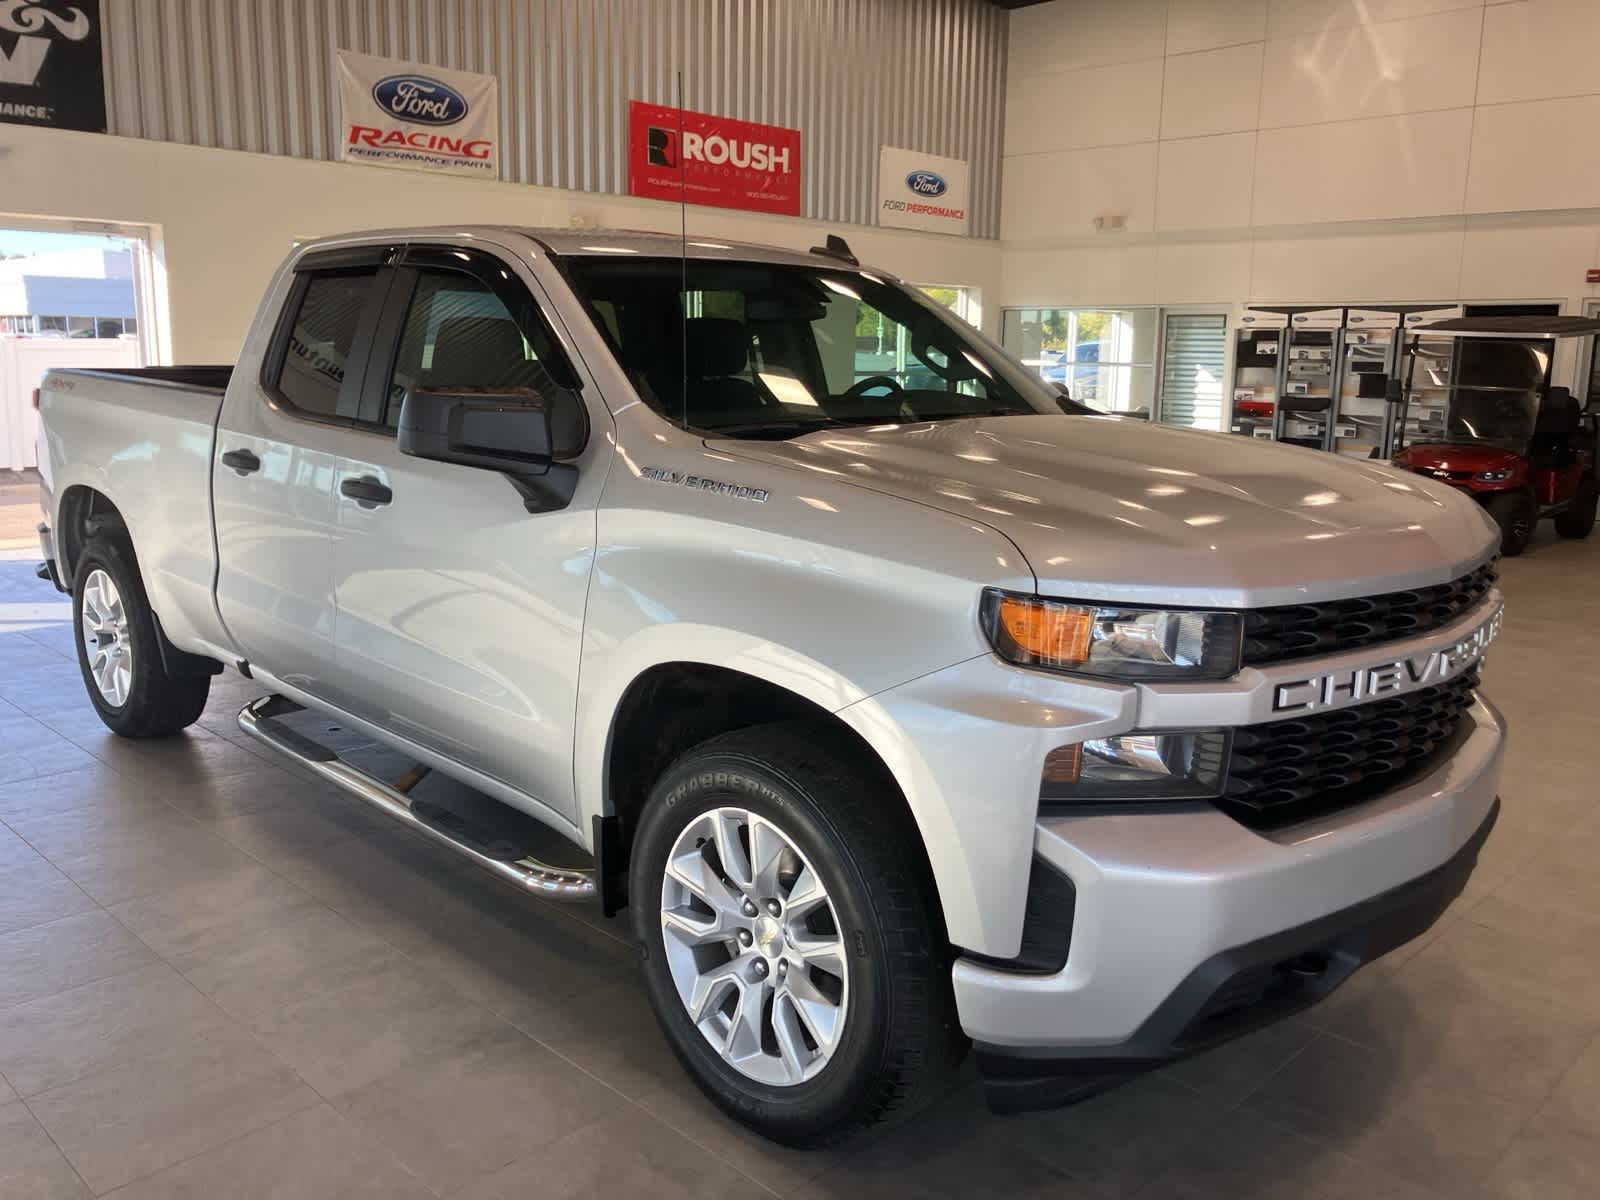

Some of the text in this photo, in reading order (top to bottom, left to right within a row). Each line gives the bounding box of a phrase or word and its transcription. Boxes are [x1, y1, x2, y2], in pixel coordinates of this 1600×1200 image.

[391, 80, 450, 119] Ford
[349, 124, 493, 160] RACING
[349, 147, 492, 170] PERFORMANCE PARTS
[682, 131, 790, 174] ROUSH
[914, 174, 940, 193] Ford
[882, 200, 965, 220] FORD PERFORMANCE
[640, 466, 769, 504] SILVERADO
[665, 771, 760, 808] GRABBER
